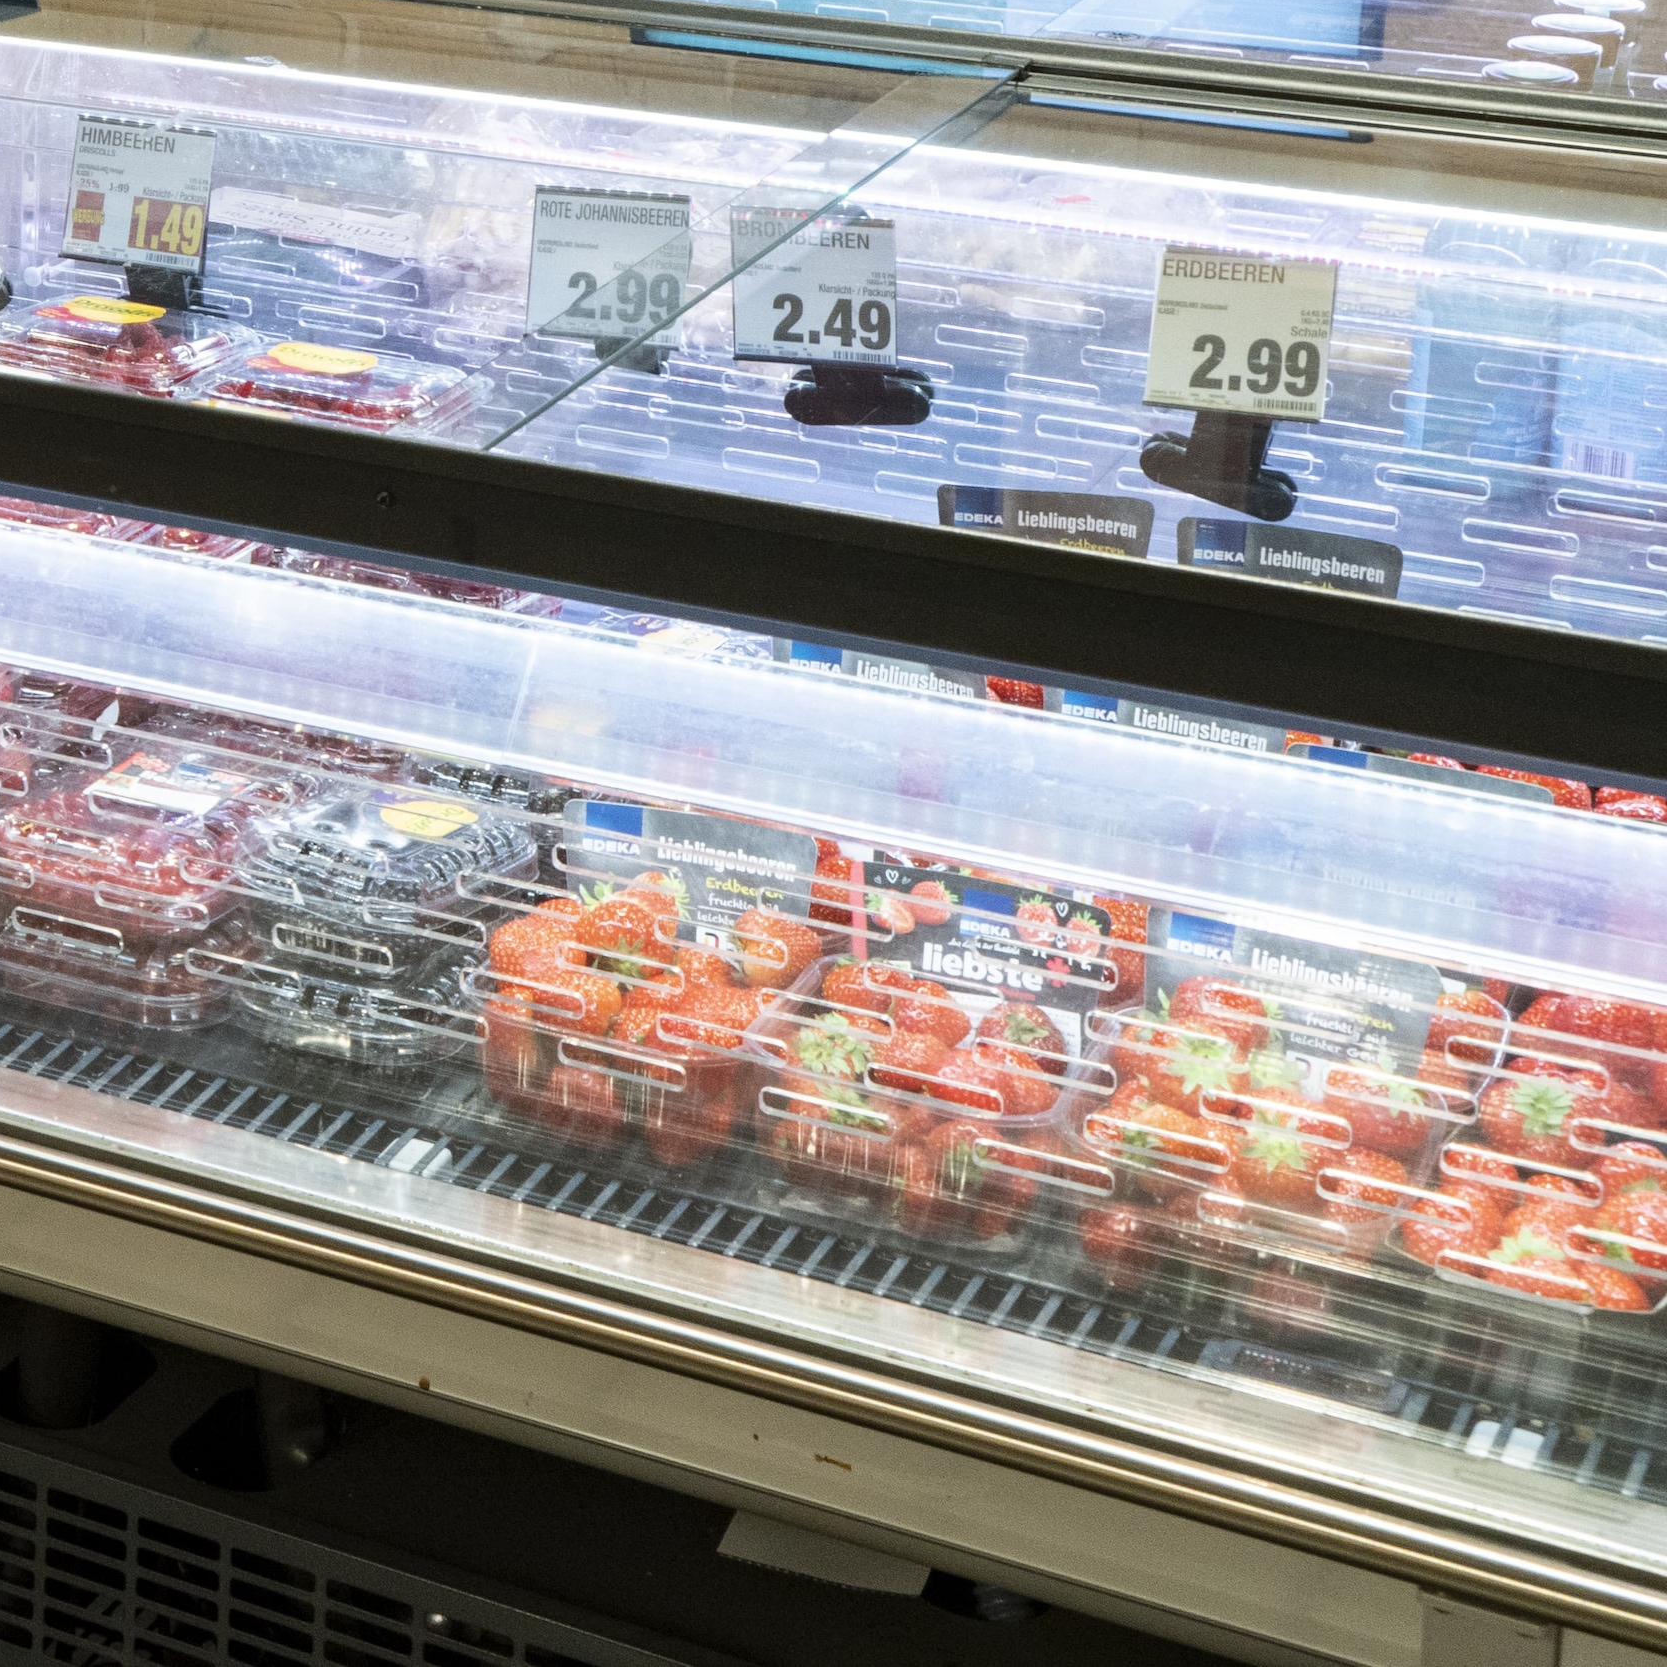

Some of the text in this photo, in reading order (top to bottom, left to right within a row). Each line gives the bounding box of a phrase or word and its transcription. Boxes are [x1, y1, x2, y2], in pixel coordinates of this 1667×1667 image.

[80, 126, 176, 158] HIMBEEREN
[134, 198, 204, 255] 1.49
[539, 200, 692, 230] ROTE JOHANNISBEEREN
[736, 217, 870, 251] BROMBEEREN
[1161, 255, 1287, 285] ERDBEEREN
[568, 270, 683, 328] 2.99
[818, 283, 897, 299] Klarsicht- Packung
[772, 291, 893, 351] 2.49
[1290, 325, 1328, 338] Schale
[1191, 335, 1321, 398] 2.99
[953, 509, 1138, 541] EDEKA Lieblingsbeeren
[1193, 547, 1246, 564] EDEKA
[1259, 547, 1386, 586] Lieblingsbeeren
[789, 658, 975, 699] EDEKA Lieblingsbeeren
[1061, 702, 1268, 752] EDEKA Lieblingsbeeren
[581, 837, 641, 856] EDEKA
[958, 920, 1011, 939] EDEKA
[922, 941, 1044, 992] liebste
[1166, 937, 1234, 964] EDEKA
